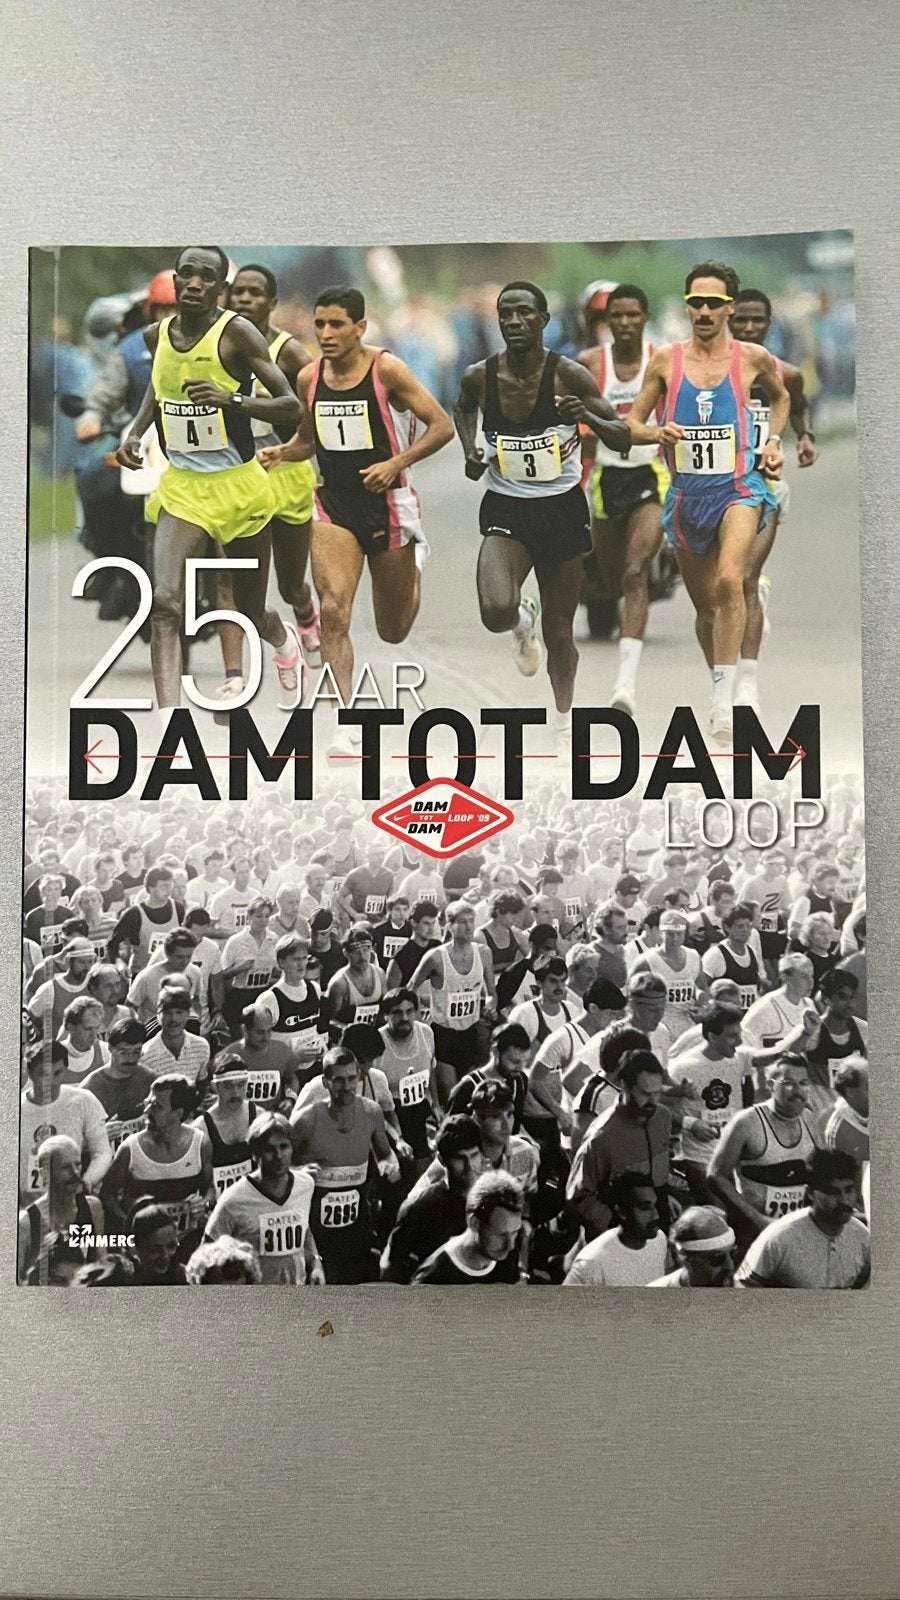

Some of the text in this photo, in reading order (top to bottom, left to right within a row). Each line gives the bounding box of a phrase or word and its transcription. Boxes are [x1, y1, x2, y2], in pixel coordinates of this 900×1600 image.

[181, 404, 194, 415] DO
[187, 420, 199, 446] 4
[337, 420, 345, 445] 1
[697, 430, 710, 440] DO
[502, 440, 519, 450] JUST
[520, 440, 534, 450] DO
[692, 443, 714, 470] 31
[523, 454, 537, 478] 3
[69, 556, 427, 711] 25 JAAR
[69, 704, 822, 801] DAM TOT DAM
[413, 801, 448, 812] DAM
[447, 814, 474, 822] LOOP
[666, 799, 825, 849] LOOP
[408, 823, 442, 834] DAM
[219, 1165, 247, 1177] DATEX
[328, 1195, 355, 1203] DATEX
[267, 1215, 299, 1226] DATEX
[264, 1225, 303, 1252] 3100
